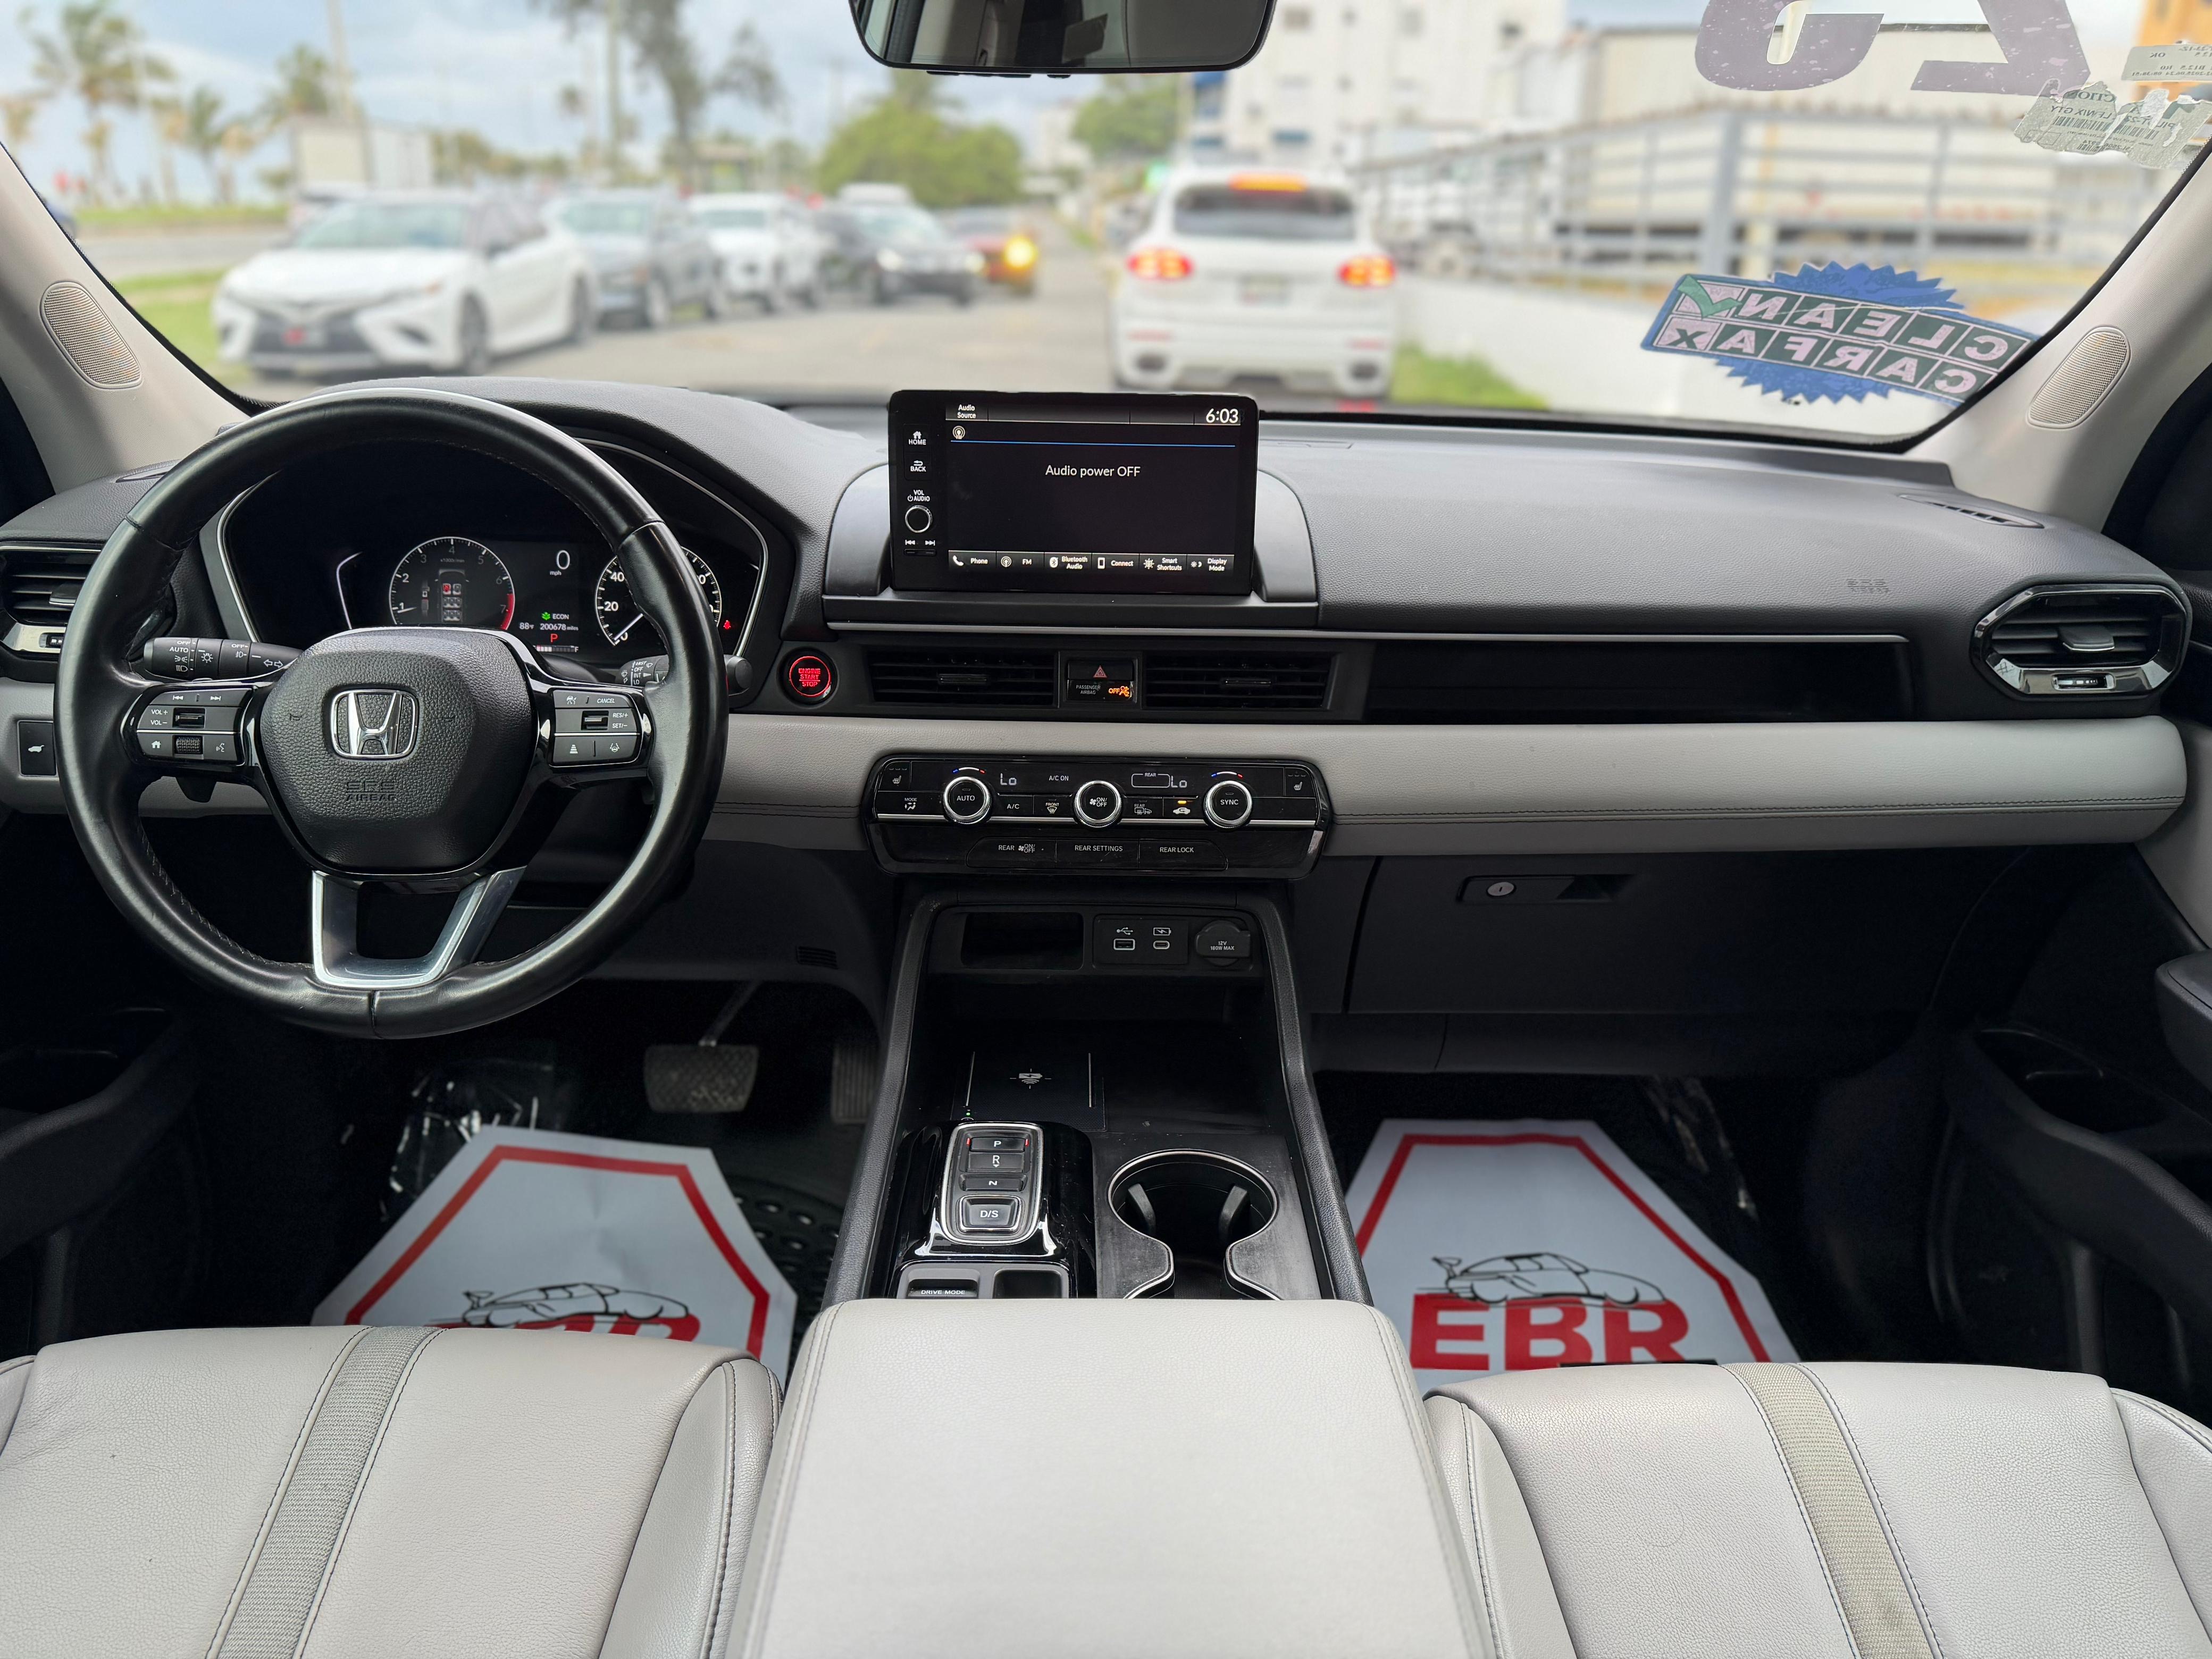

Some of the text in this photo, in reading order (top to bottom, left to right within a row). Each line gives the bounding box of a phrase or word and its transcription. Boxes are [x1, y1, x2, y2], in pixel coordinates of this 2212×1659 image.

[1206, 408, 1238, 423] 6:03
[1045, 465, 1141, 478] Audio power OFF
[421, 555, 427, 563] 3
[477, 556, 484, 565] 5
[556, 550, 571, 570] 0
[403, 573, 409, 583] 2
[496, 576, 502, 584] 6
[610, 572, 625, 582] 40
[604, 601, 619, 611] 20
[550, 633, 558, 643] P
[992, 1155, 1000, 1164] R
[1409, 1294, 1689, 1370] EBR
